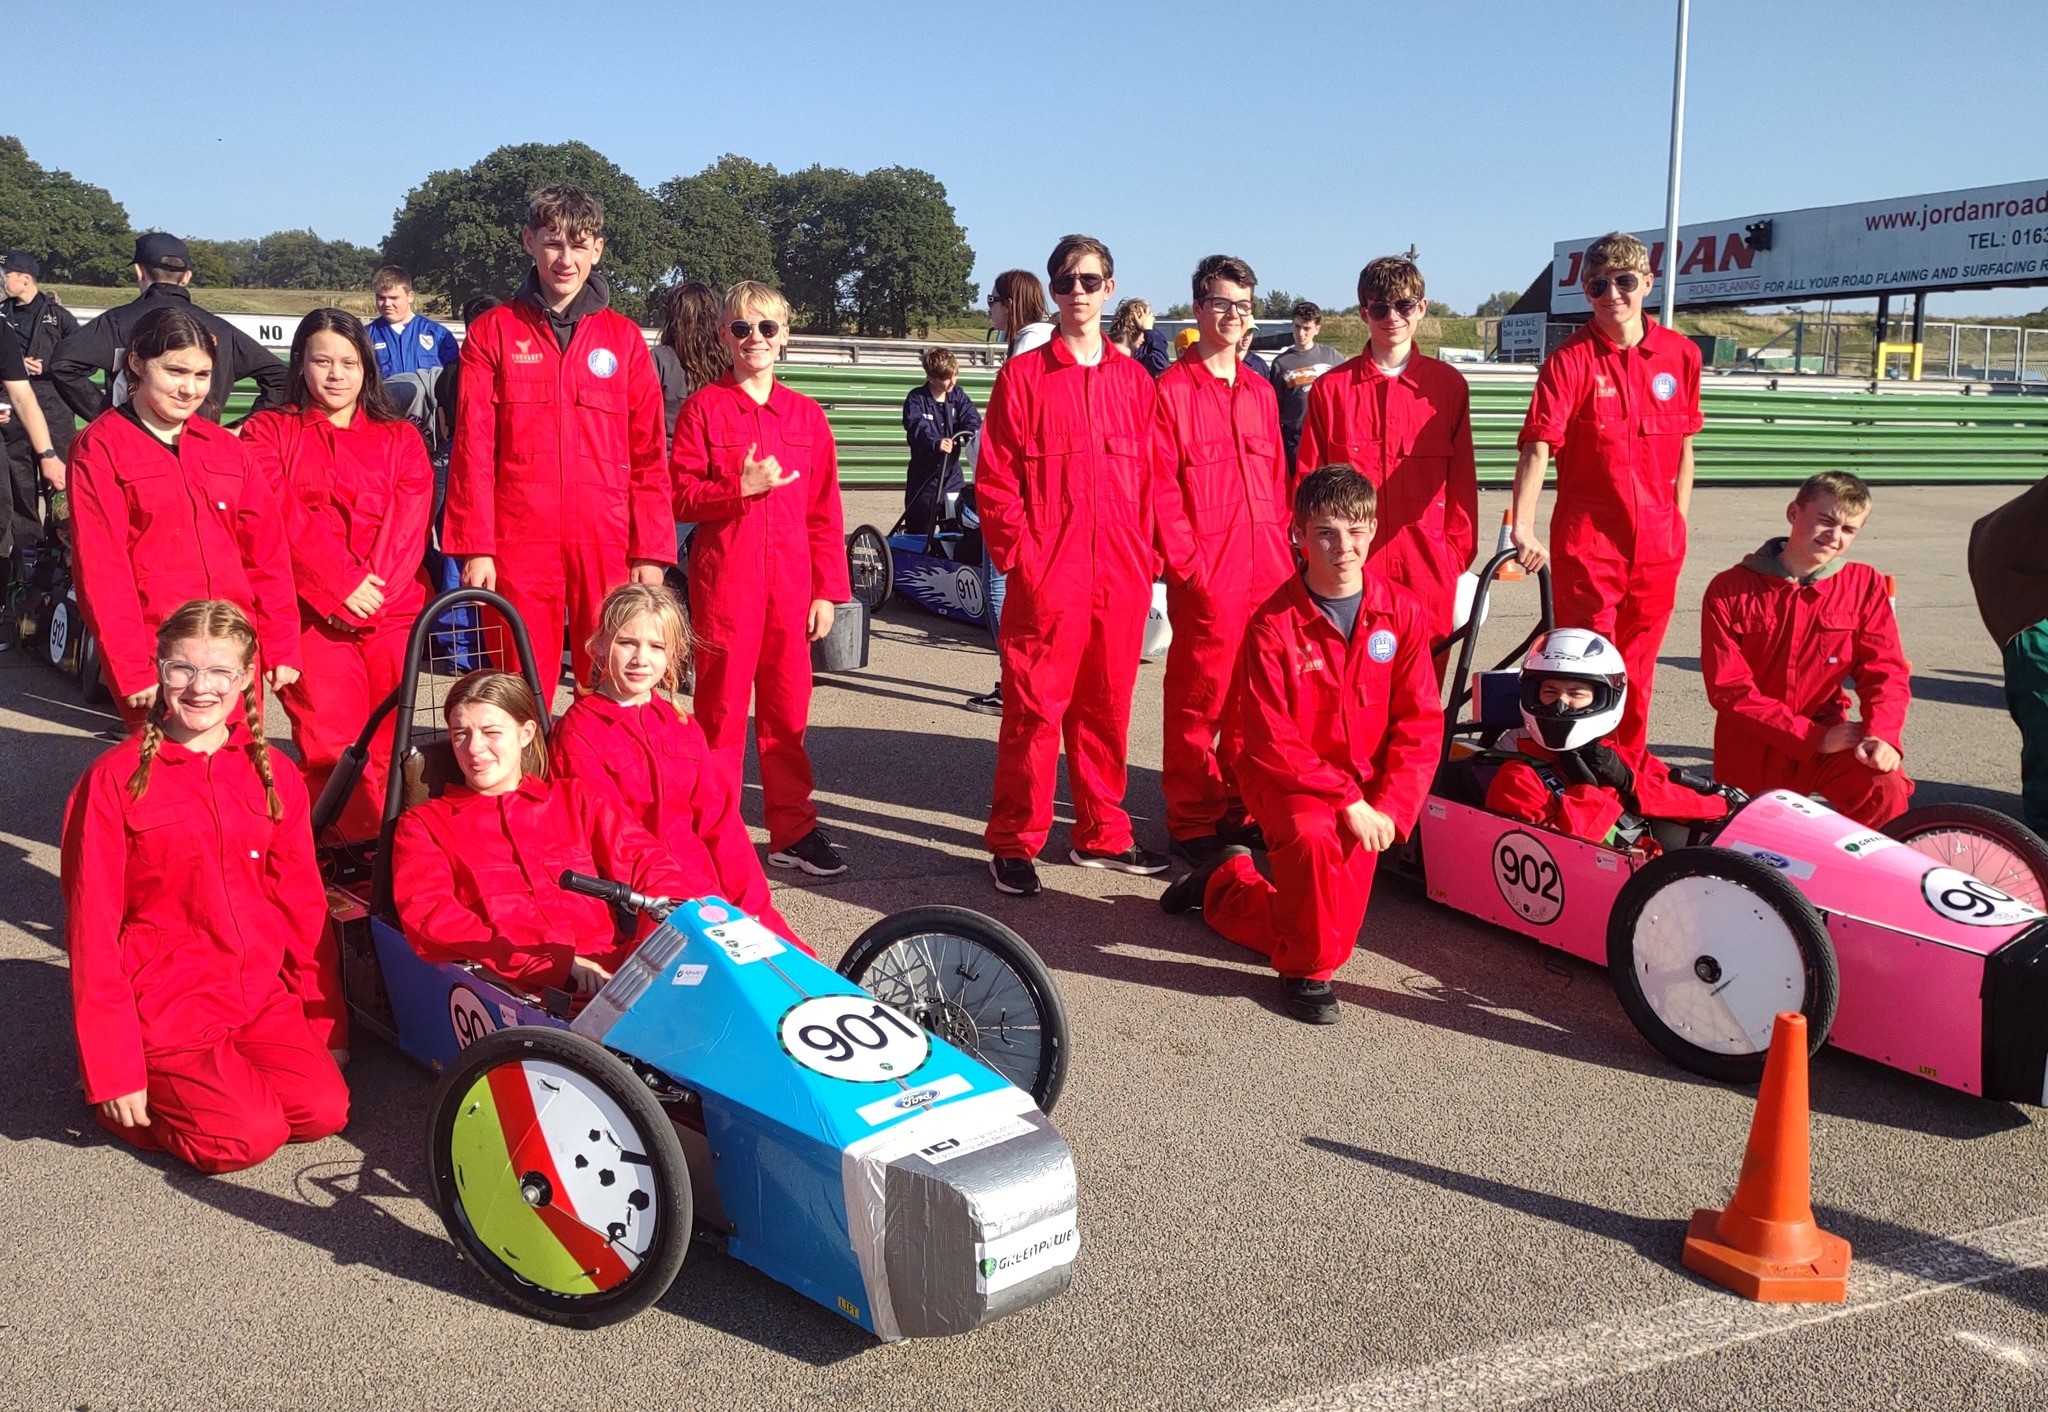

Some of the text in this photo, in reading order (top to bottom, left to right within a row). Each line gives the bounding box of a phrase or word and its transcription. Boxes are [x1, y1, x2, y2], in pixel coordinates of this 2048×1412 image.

[1866, 190, 2048, 231] www.jordanroad
[1968, 232, 2006, 250] TEL:
[1558, 232, 1760, 287] JDAN
[1764, 281, 1784, 293] FOR
[1786, 278, 1807, 291] ALL
[1809, 275, 1841, 289] YOUR
[1842, 273, 1874, 286] ROAD
[1875, 268, 1929, 285] PLANING
[1931, 265, 1958, 280] AND
[1962, 259, 2037, 278] SURFACING
[1689, 279, 1760, 295] ROAD PLANING
[259, 325, 283, 340] NO
[957, 578, 978, 600] 911
[52, 618, 65, 649] 912
[1499, 845, 1560, 905] 902
[1940, 880, 2015, 918] 90
[454, 1003, 495, 1048] 90
[798, 1004, 919, 1062] 901
[902, 1090, 933, 1107] Ford
